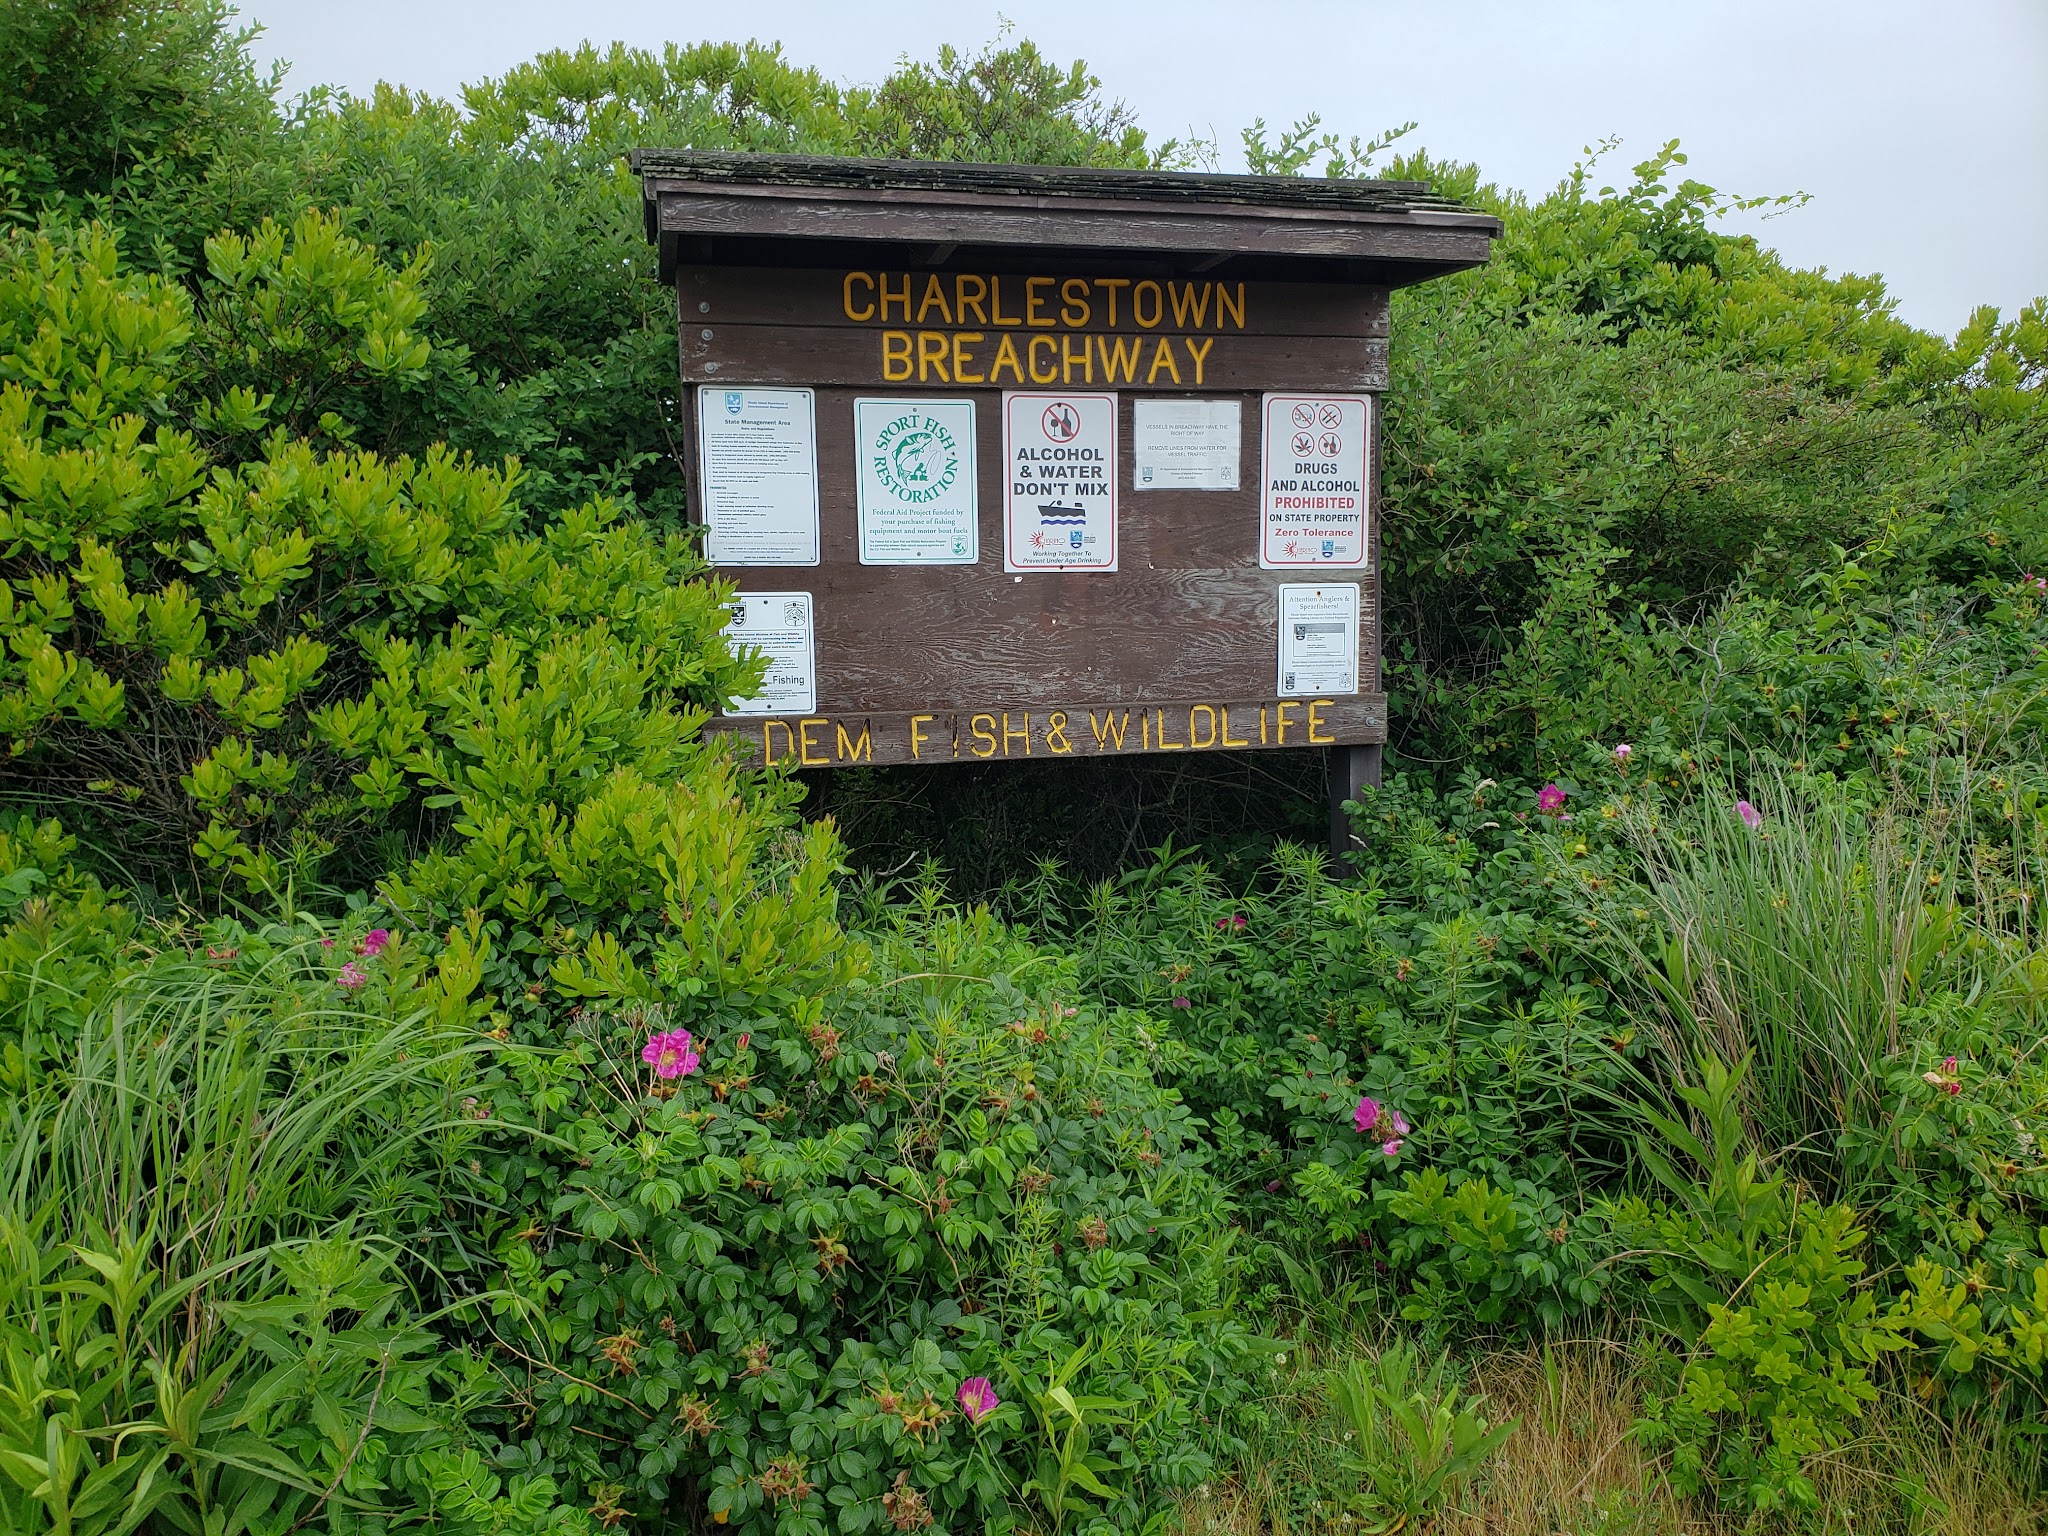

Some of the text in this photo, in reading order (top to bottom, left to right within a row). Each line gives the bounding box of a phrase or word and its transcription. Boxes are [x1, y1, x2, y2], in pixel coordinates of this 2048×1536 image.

[843, 271, 1245, 330] CHARLESTOWN
[882, 330, 1214, 385] BREACHWAY
[876, 415, 956, 451] SPORT FISH
[1017, 447, 1104, 461] ALCOHOL
[1019, 465, 1103, 478] & WATER
[1294, 463, 1338, 475] DRUGS
[873, 456, 959, 504] RESTORATION
[1271, 480, 1360, 492] AND ALCOHOL
[1013, 482, 1108, 496] DON'T MIX
[1275, 497, 1355, 509] PROHIBITED
[872, 508, 965, 519] Federal Aid Project funded by
[1269, 514, 1360, 522] ON STATE PROPERTY
[881, 519, 896, 527] your
[897, 518, 925, 527] purchase
[934, 518, 956, 527] fishing
[869, 527, 902, 536] equipment
[1275, 528, 1354, 537] Zero Tolerance
[1319, 596, 1343, 604] Anglers
[1299, 603, 1339, 611] Spearfishers!
[773, 675, 805, 686] Fishing
[764, 700, 1335, 766] DEM FISH & WILDLIFE
